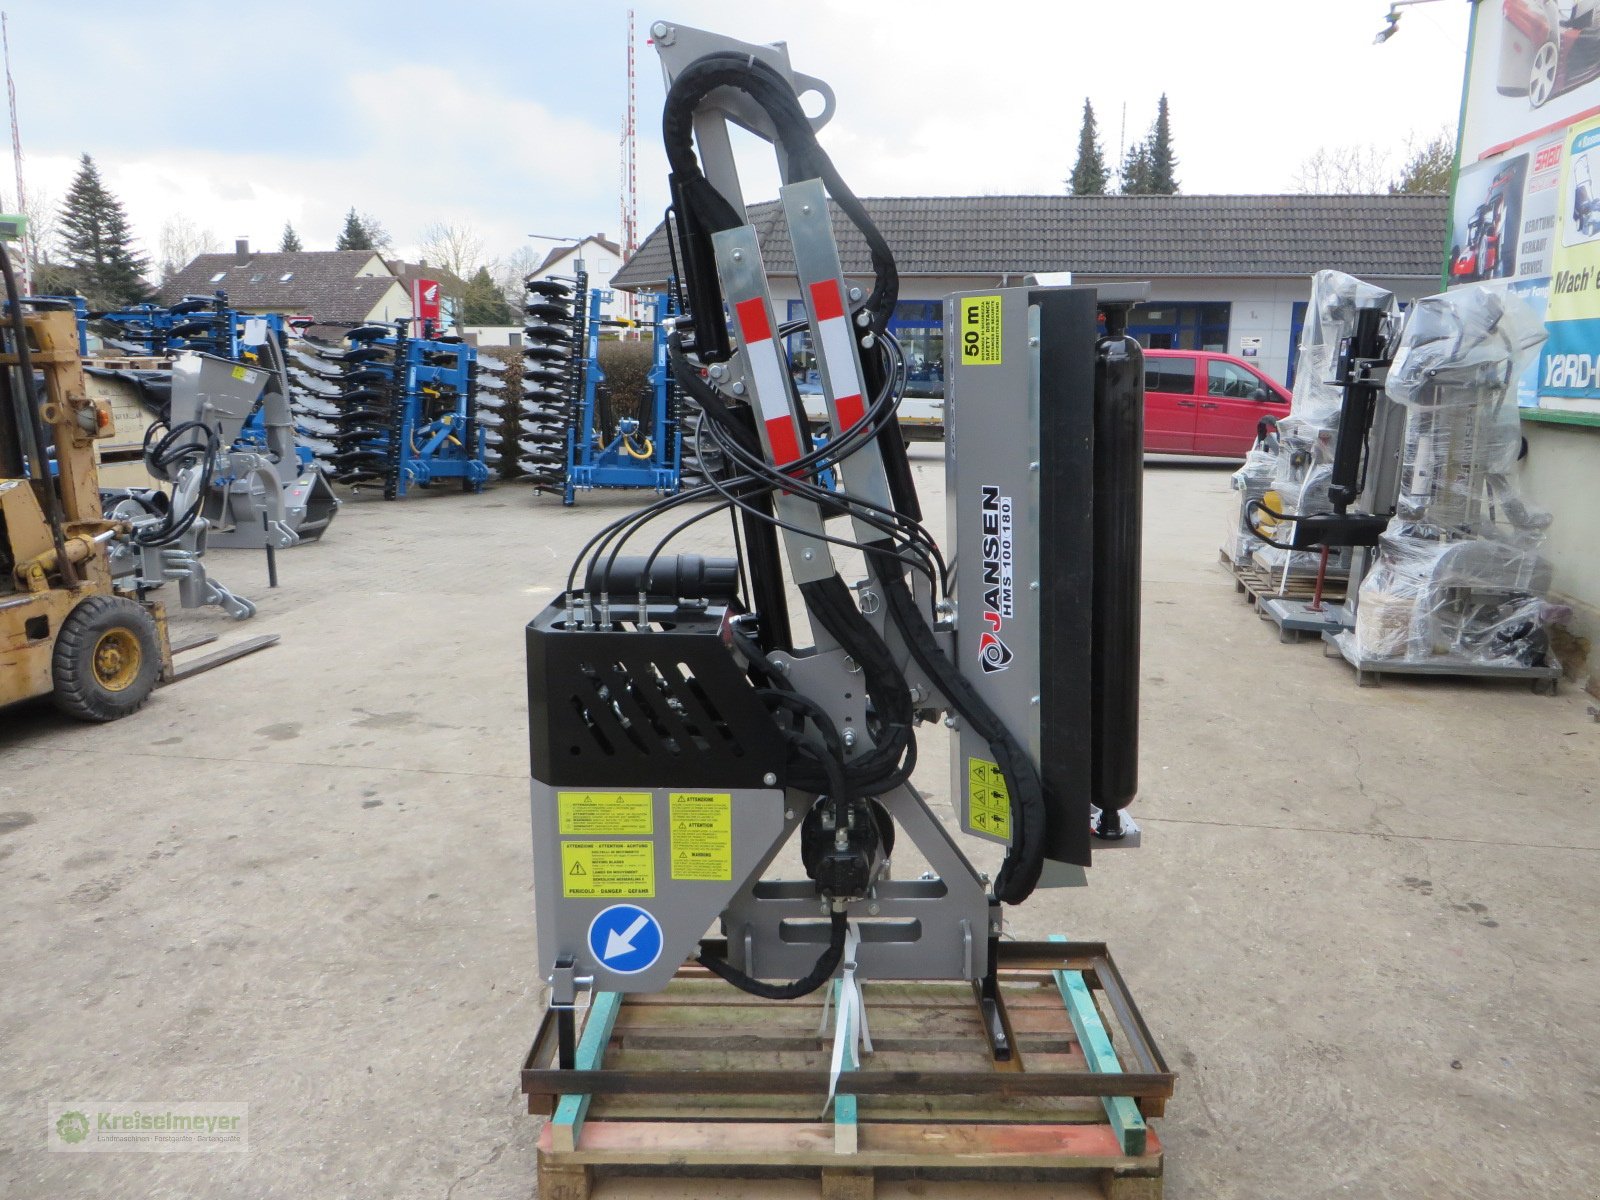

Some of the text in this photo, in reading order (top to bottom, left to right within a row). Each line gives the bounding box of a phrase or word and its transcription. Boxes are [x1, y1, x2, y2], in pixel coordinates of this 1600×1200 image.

[1534, 143, 1563, 172] SABO
[1524, 214, 1556, 234] BERATUNG
[1521, 237, 1548, 255] VERKAUF
[1520, 259, 1543, 275] SERVICE
[965, 306, 980, 357] 50 m
[982, 485, 1001, 633] JANSEN
